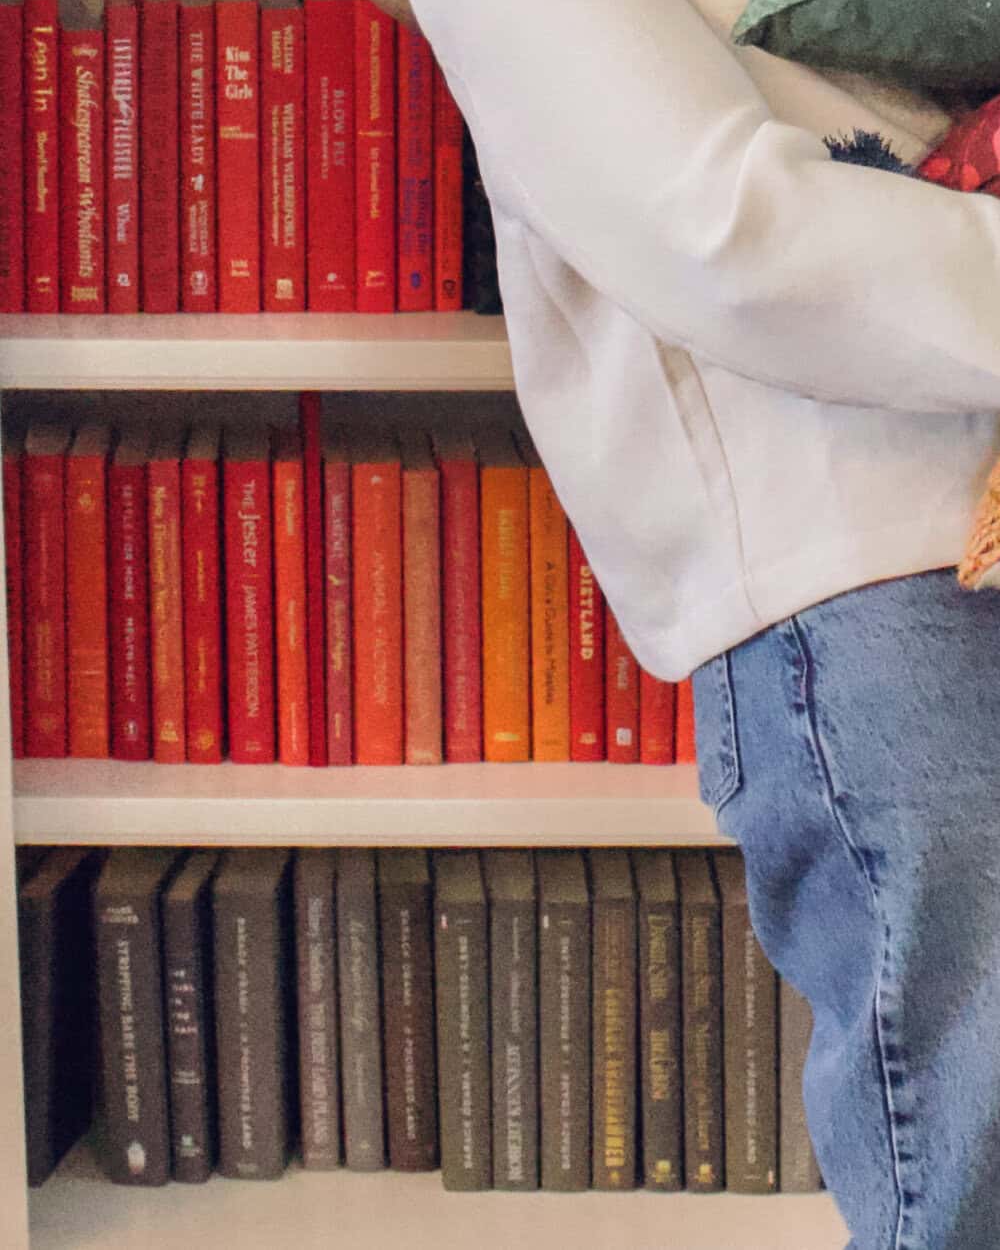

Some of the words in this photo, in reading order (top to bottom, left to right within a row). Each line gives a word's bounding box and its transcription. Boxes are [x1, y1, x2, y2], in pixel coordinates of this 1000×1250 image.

[72, 66, 99, 183] Shakespearean
[243, 480, 255, 509] THE
[238, 511, 261, 566] Jester
[242, 585, 258, 630] JAMES
[580, 566, 595, 660] DIETLAND
[244, 633, 259, 717] PATTERSON
